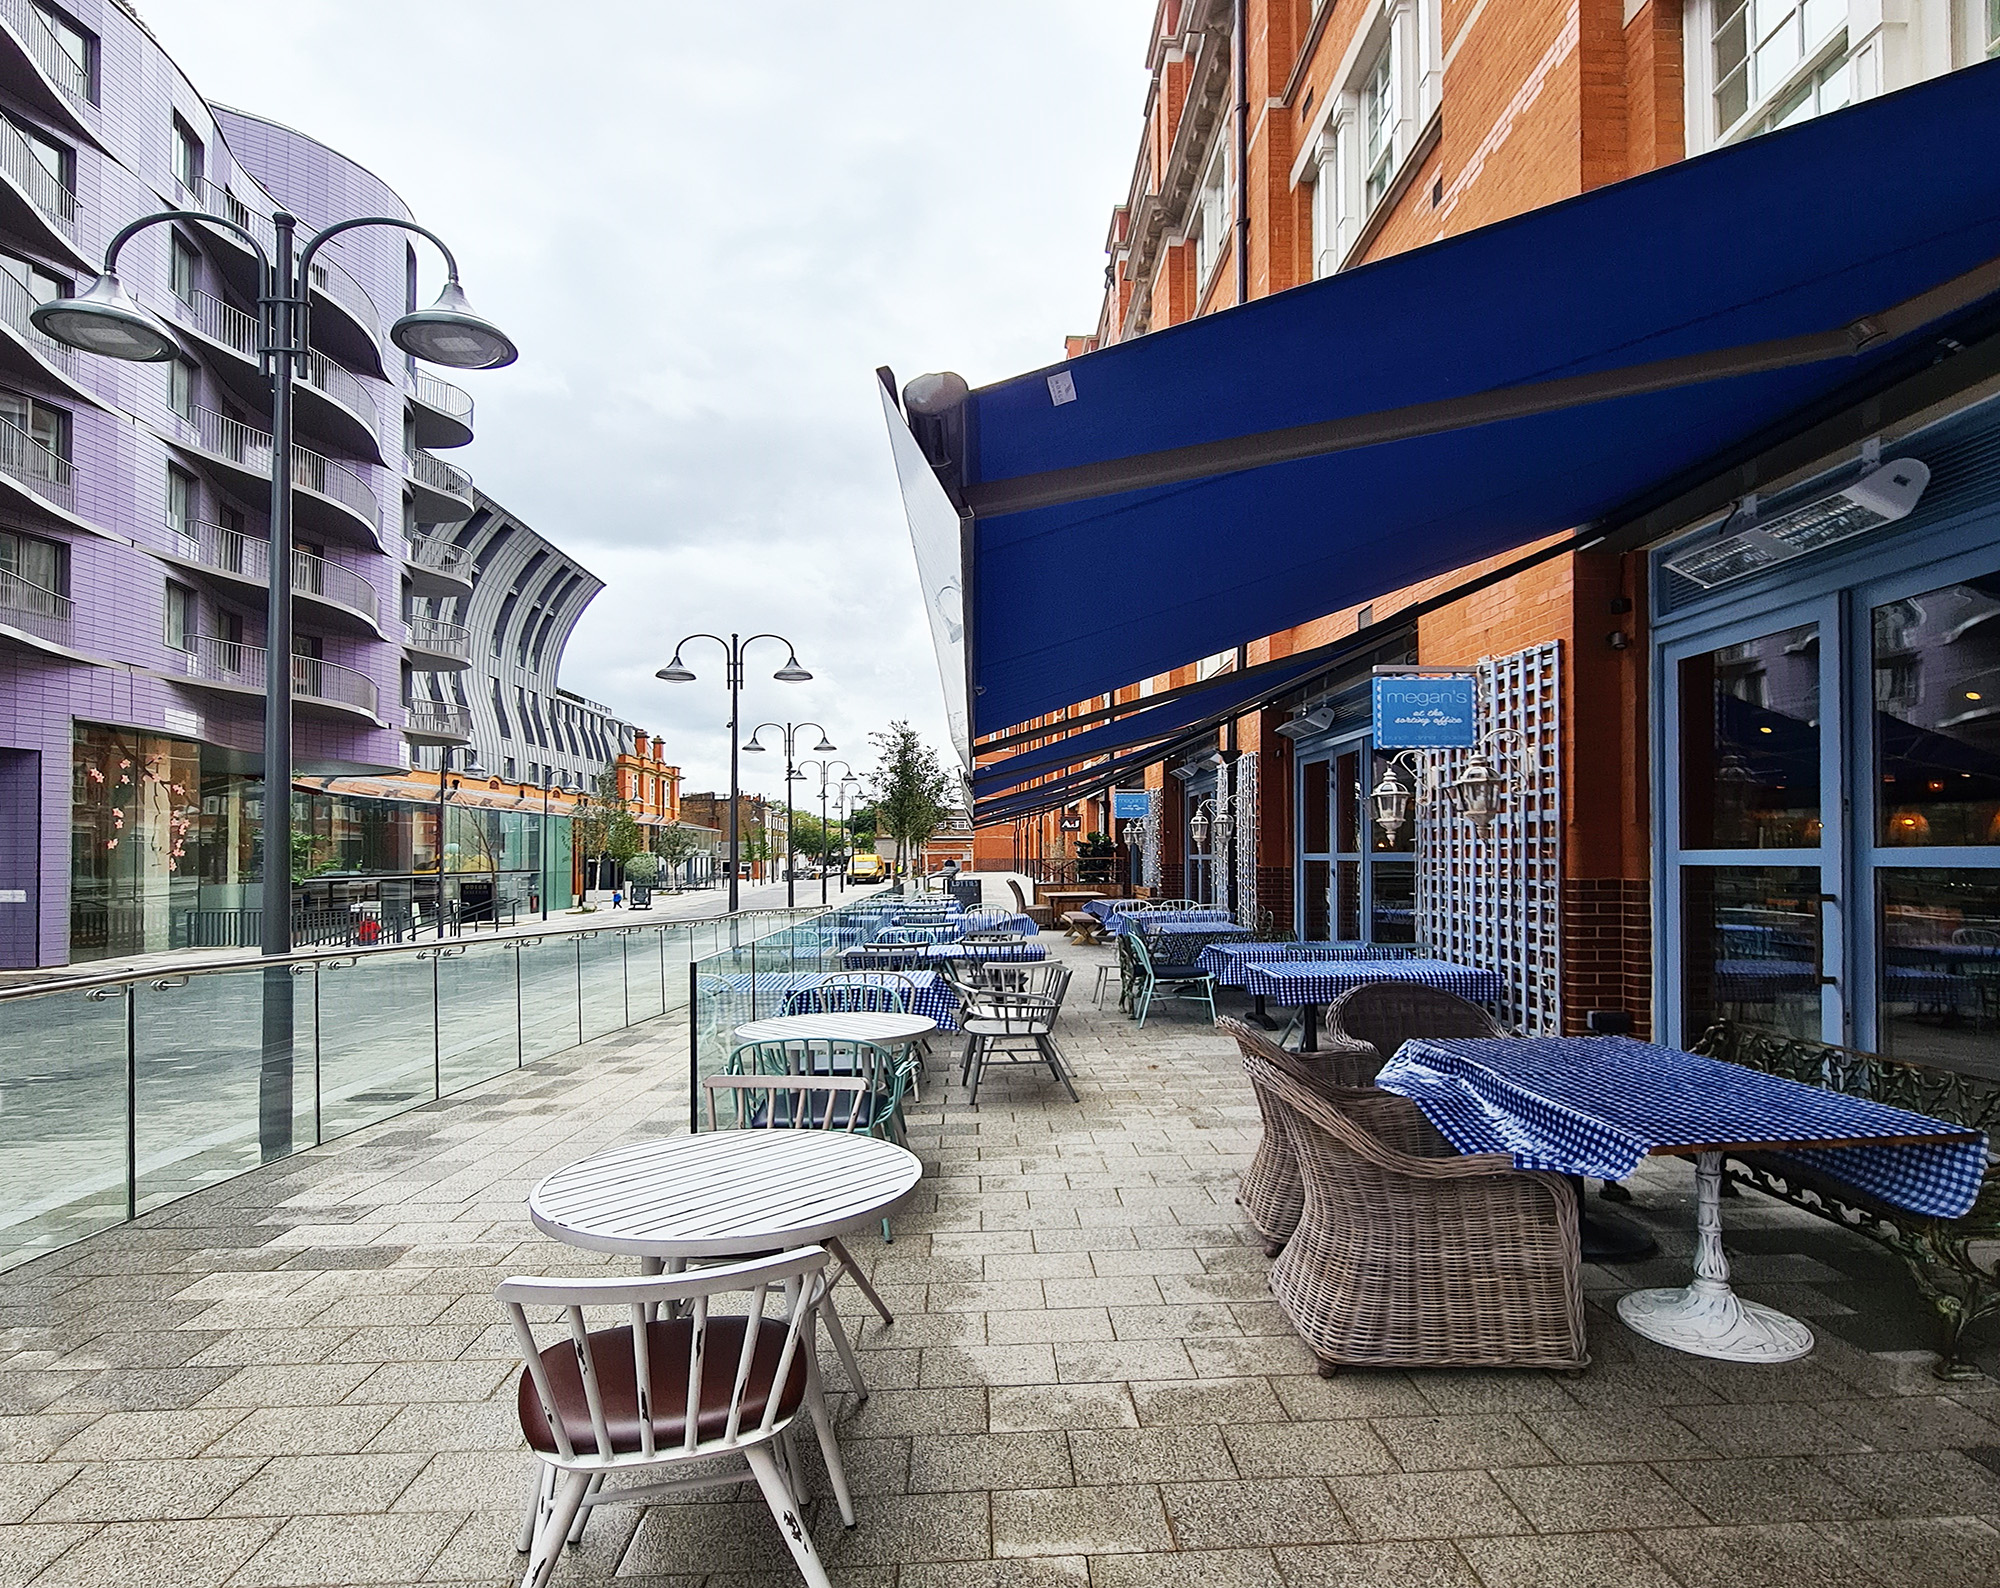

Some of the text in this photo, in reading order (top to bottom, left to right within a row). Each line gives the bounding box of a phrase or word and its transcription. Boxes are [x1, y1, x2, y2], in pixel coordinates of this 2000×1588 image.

[1386, 689, 1468, 707] megan's
[1427, 708, 1444, 717] the
[1394, 716, 1463, 727] sorting office
